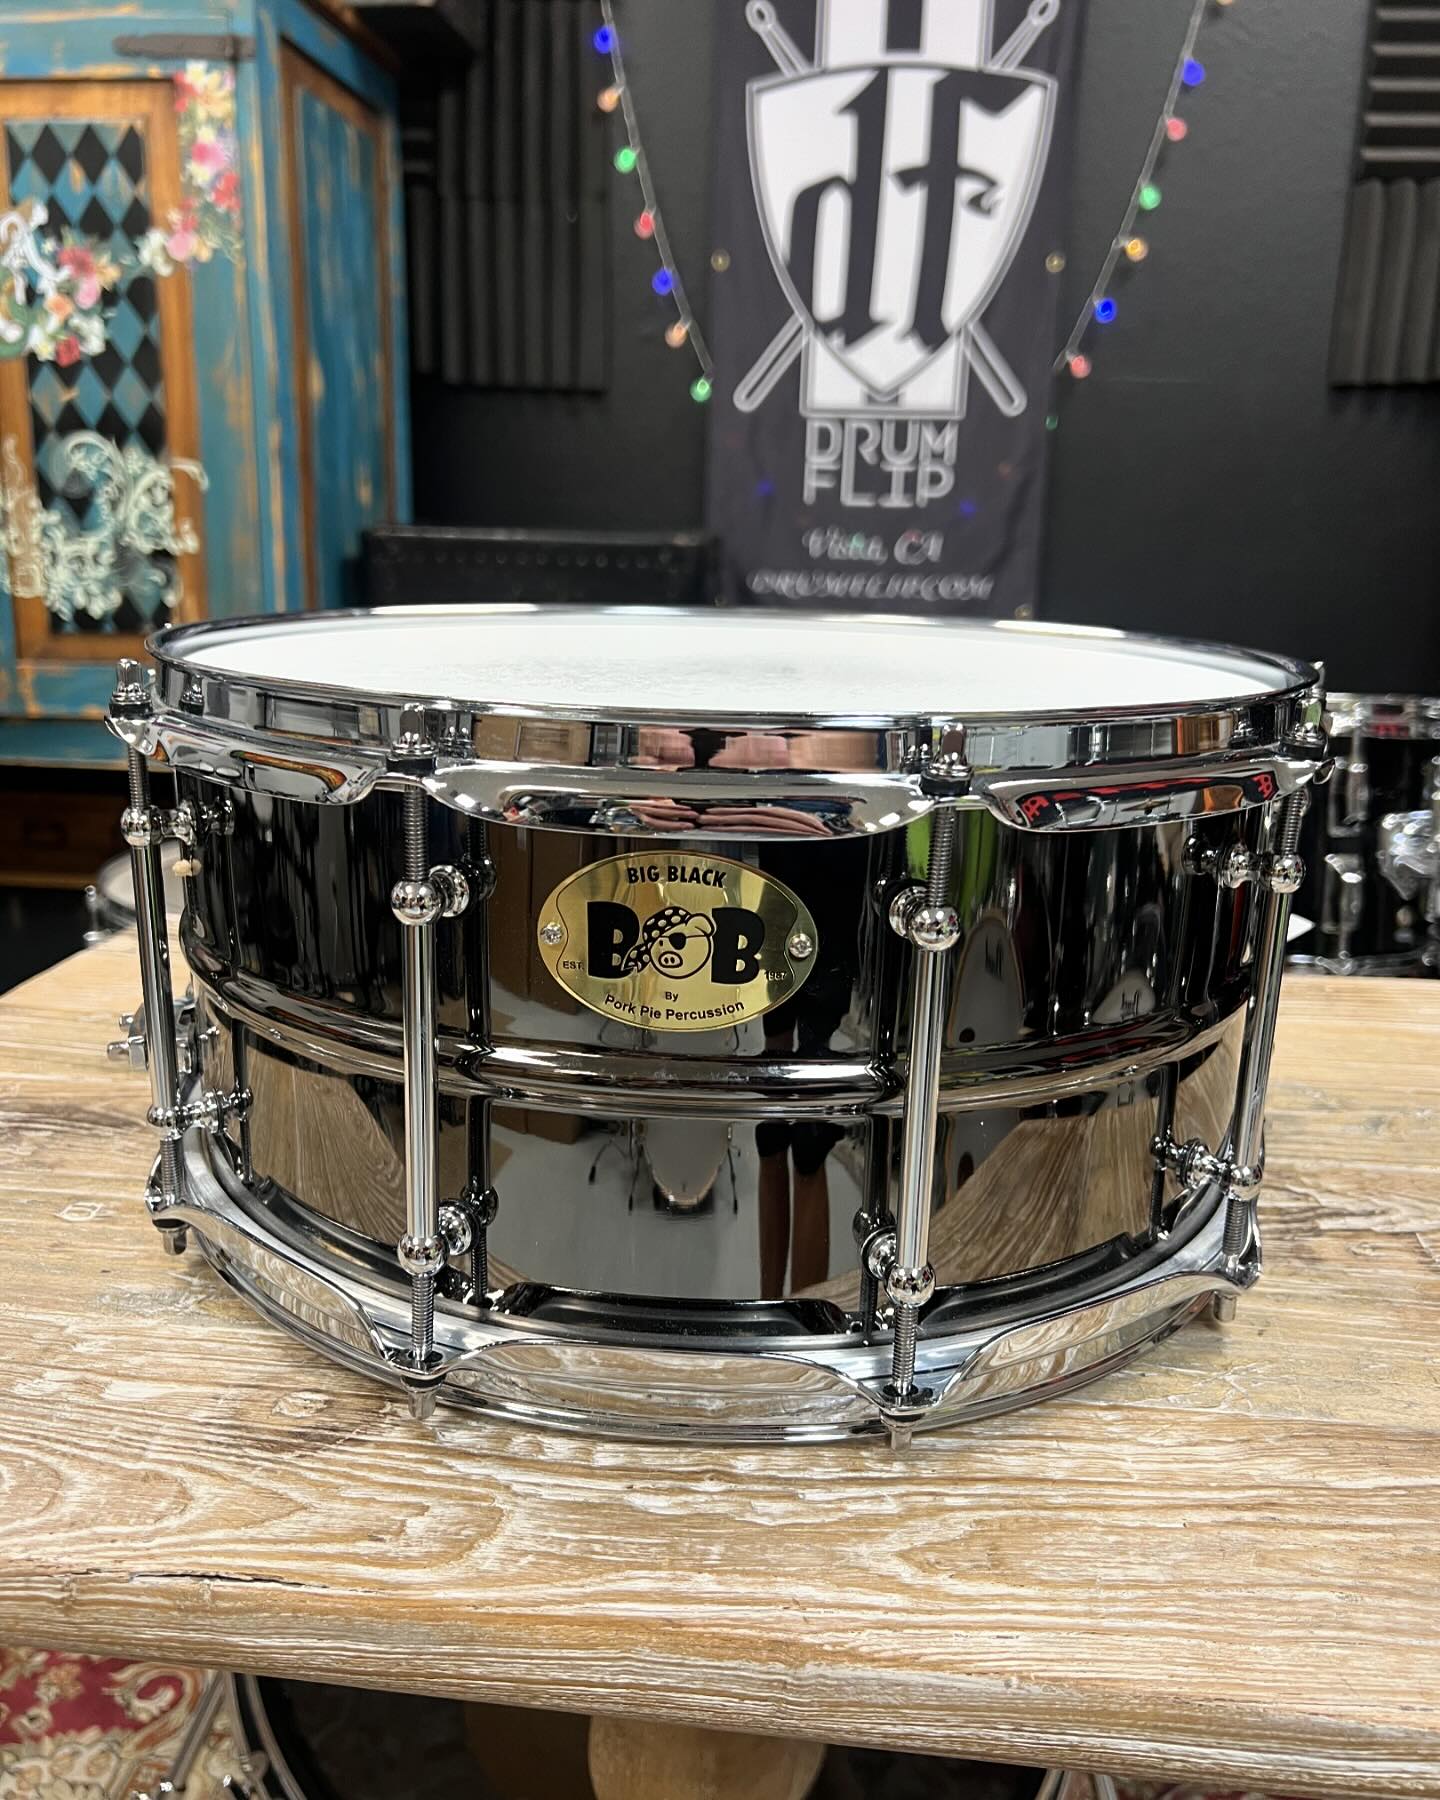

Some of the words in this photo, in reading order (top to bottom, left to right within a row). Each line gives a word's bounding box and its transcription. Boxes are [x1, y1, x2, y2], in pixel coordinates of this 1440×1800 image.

[805, 418, 959, 465] DRUM
[803, 462, 955, 508] FLIP
[627, 865, 660, 884] BIG
[667, 865, 727, 888] BLACK
[562, 960, 584, 970] EST.
[604, 994, 636, 1014] Pork
[640, 1005, 661, 1019] Pie
[666, 1001, 745, 1020] Percussion
[665, 991, 679, 1002] By
